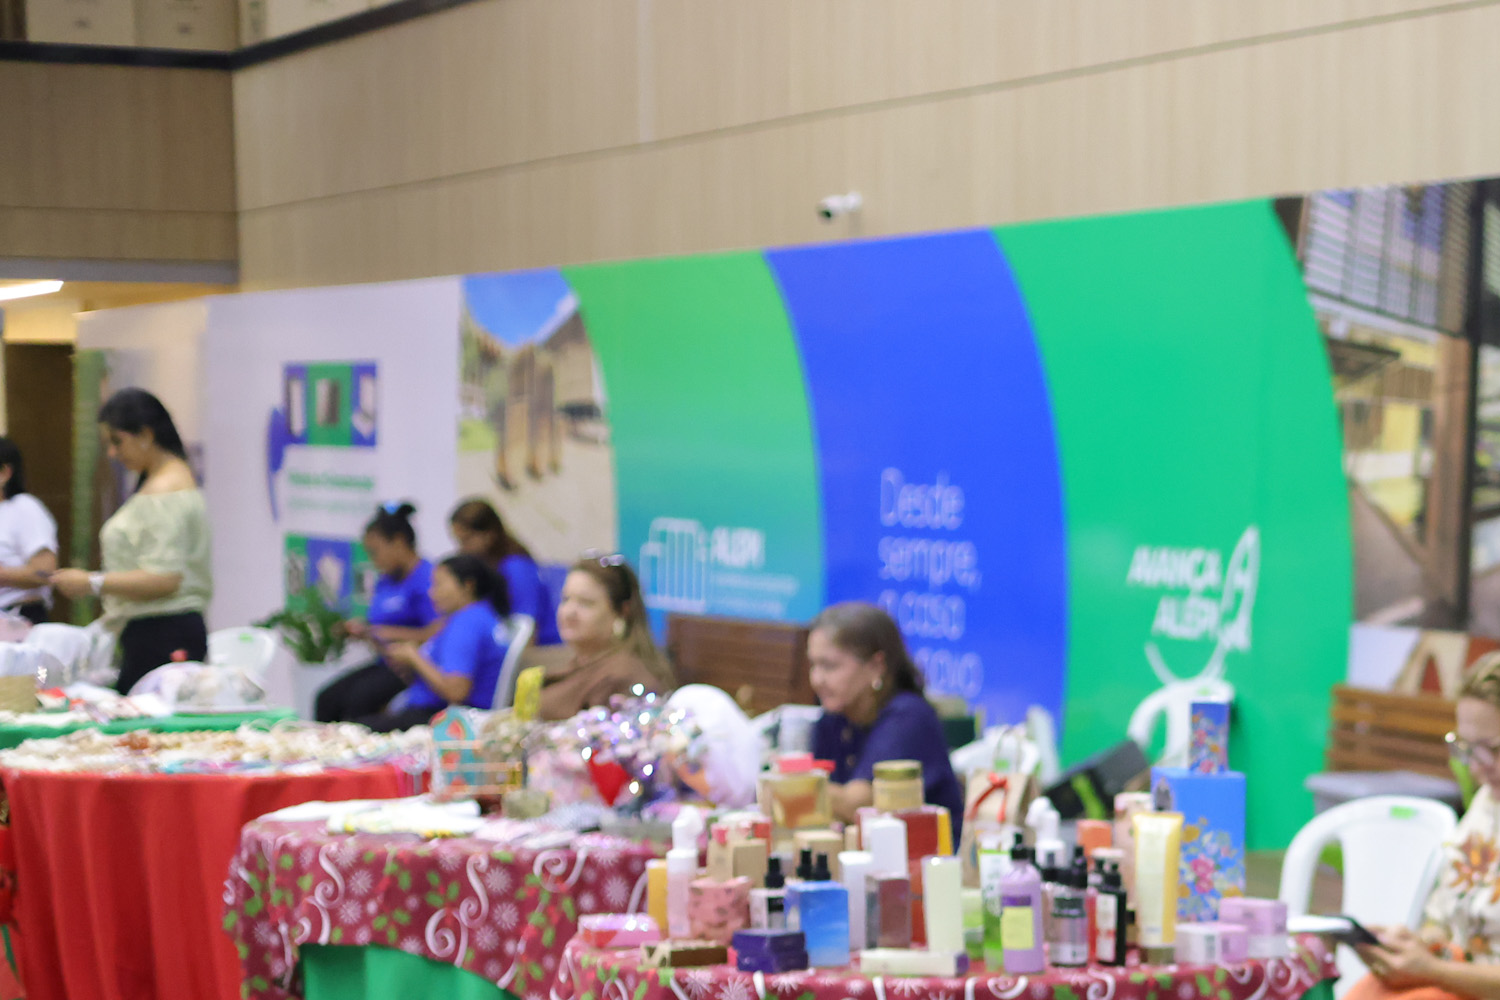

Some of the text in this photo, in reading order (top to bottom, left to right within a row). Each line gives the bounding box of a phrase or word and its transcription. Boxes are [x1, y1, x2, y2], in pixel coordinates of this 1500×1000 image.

[880, 466, 965, 531] Desde
[878, 536, 982, 594] sempre,
[900, 591, 966, 641] casa
